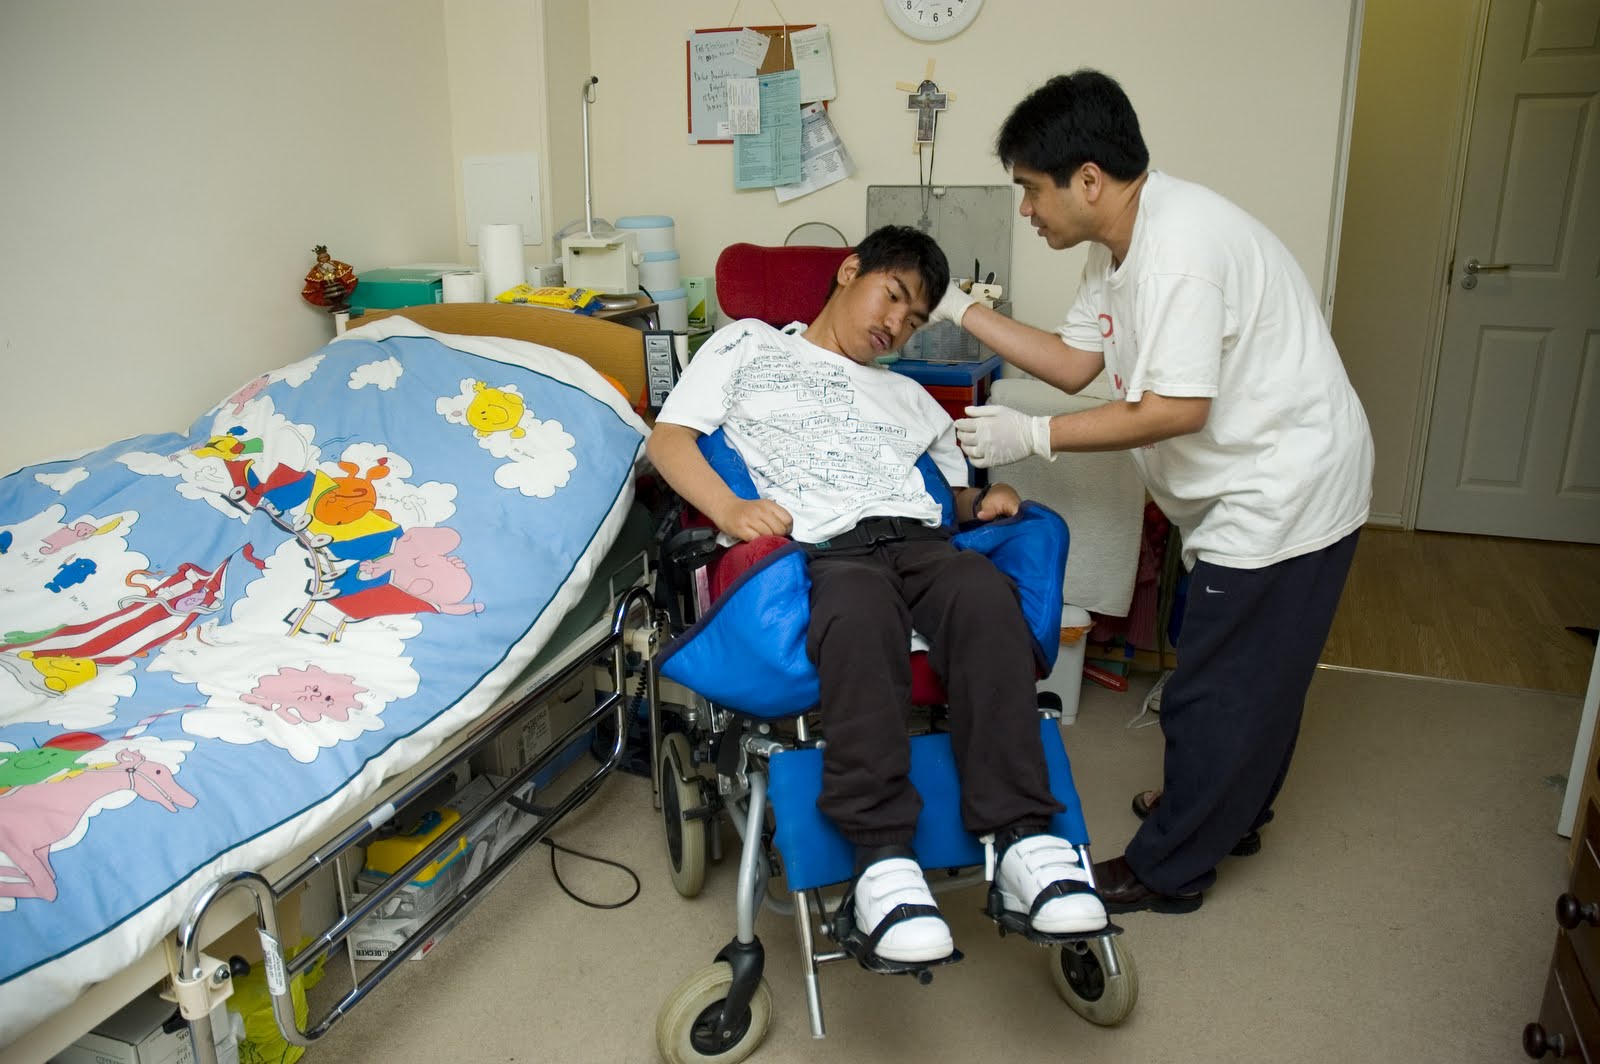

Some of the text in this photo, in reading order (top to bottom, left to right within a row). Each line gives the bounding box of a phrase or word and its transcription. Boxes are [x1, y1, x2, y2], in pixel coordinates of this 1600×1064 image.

[906, 0, 912, 10] 8
[918, 10, 924, 20] 7
[932, 12, 939, 22] 6
[947, 7, 953, 17] 5
